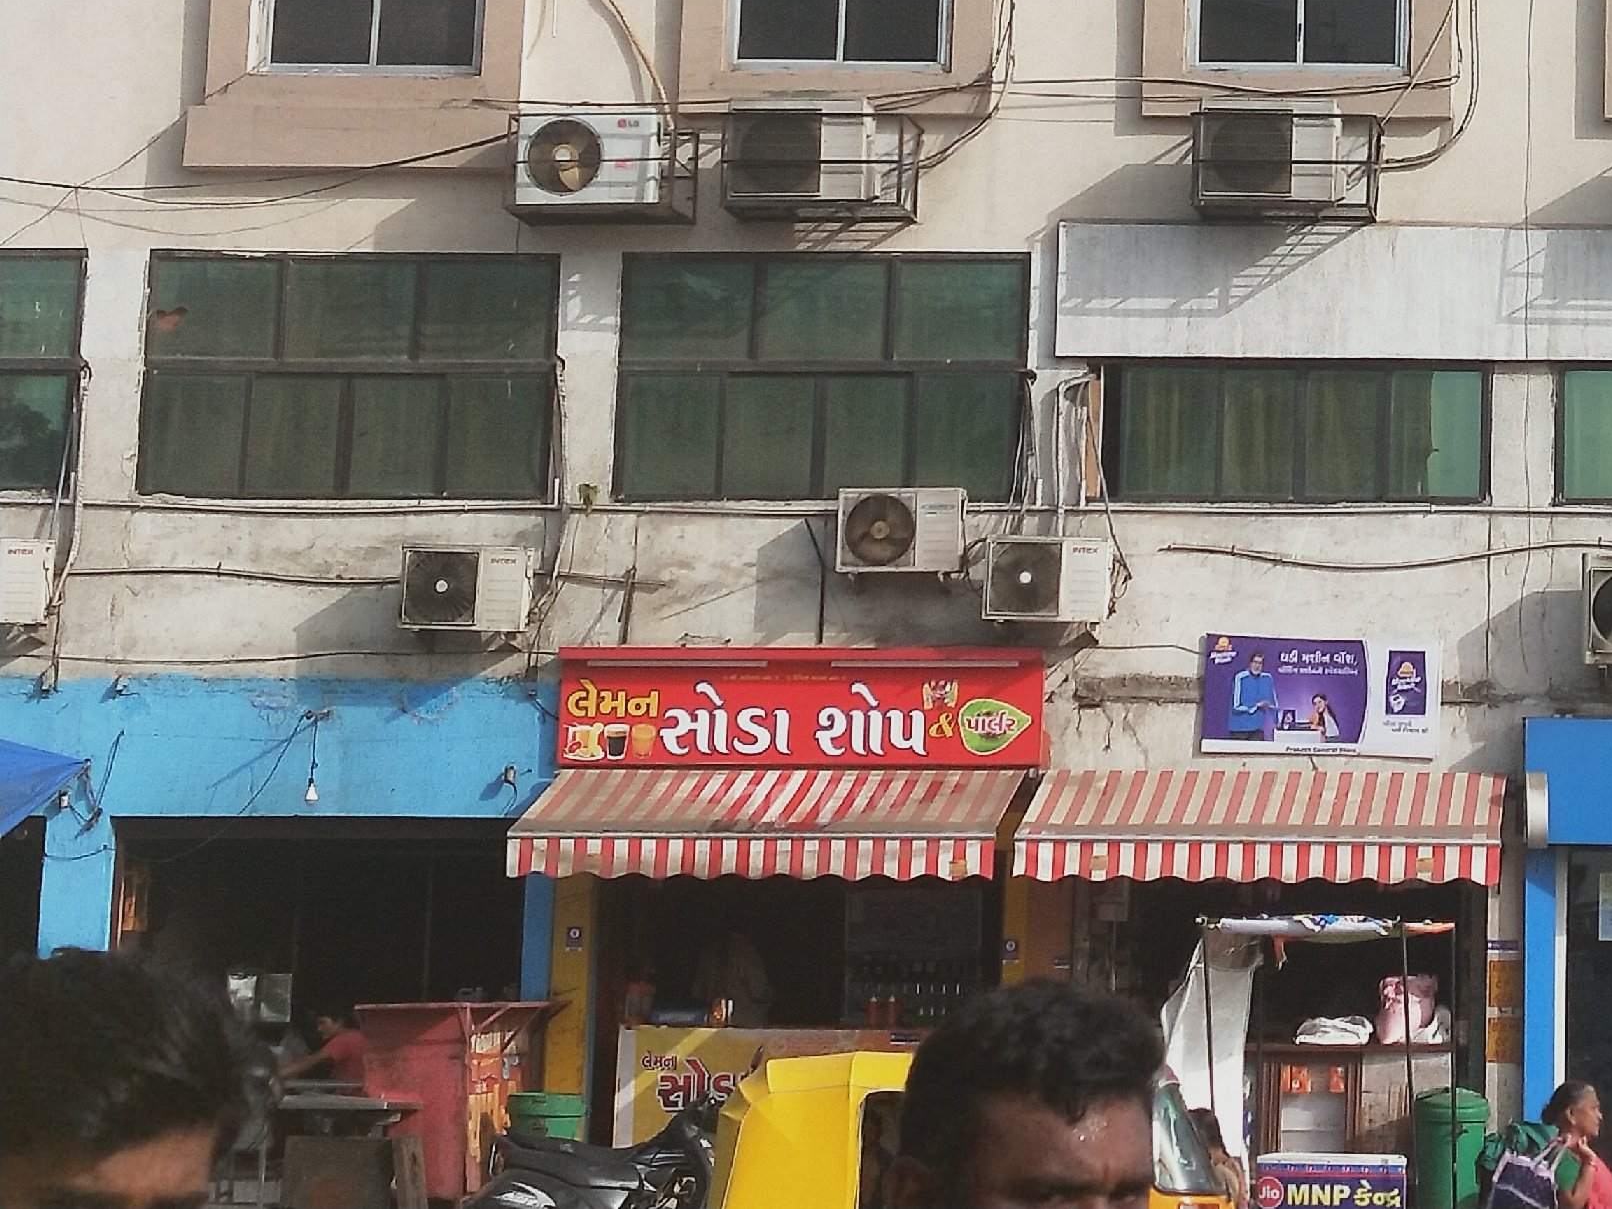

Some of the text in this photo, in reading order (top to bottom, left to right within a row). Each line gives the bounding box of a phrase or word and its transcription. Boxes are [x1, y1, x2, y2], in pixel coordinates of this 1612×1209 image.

[566, 677, 659, 718] લેમન
[659, 681, 793, 757] સોડા
[815, 681, 929, 757] શોપ
[928, 712, 955, 739] &
[1258, 1184, 1281, 1200] Jio
[1287, 1183, 1351, 1206] MNP
